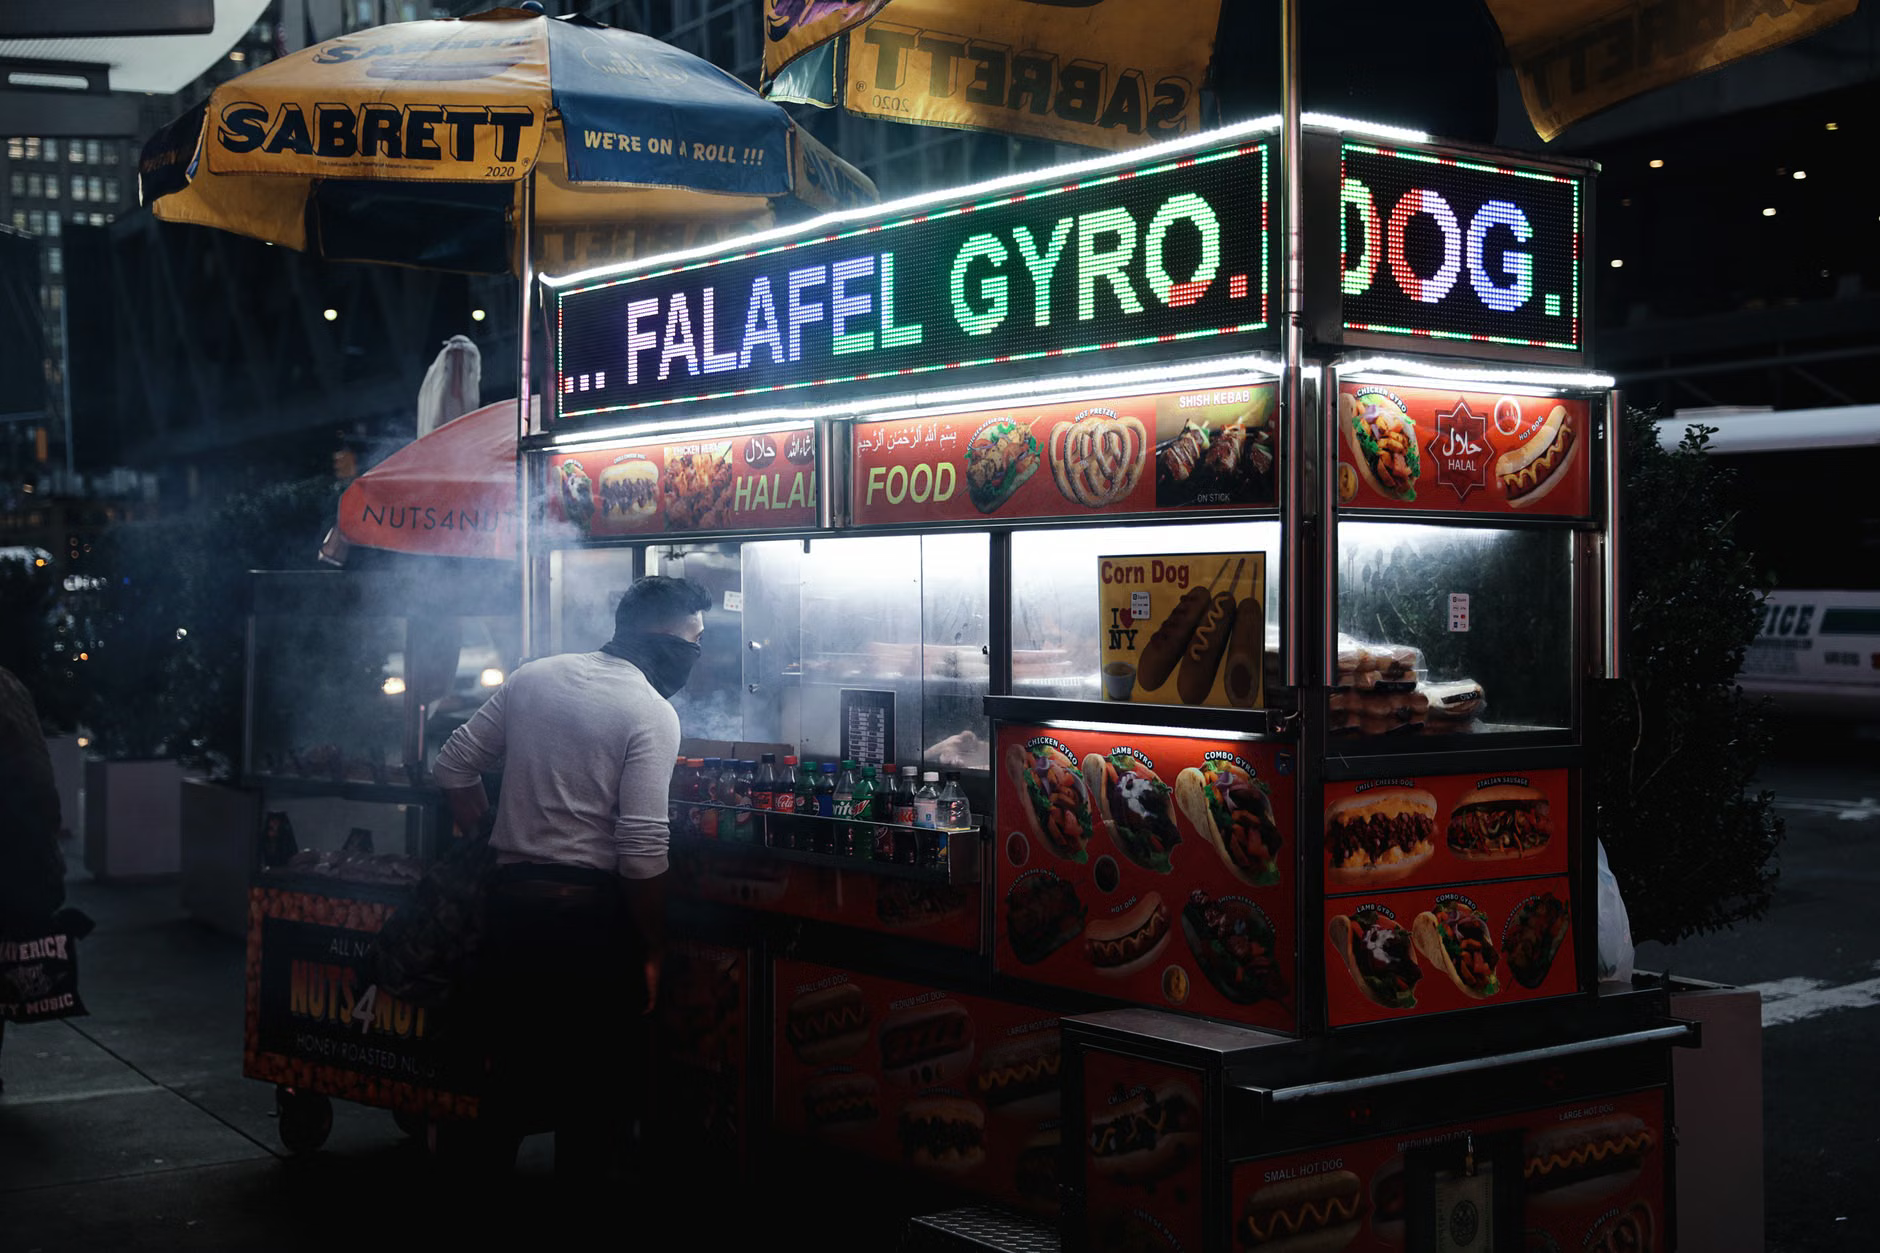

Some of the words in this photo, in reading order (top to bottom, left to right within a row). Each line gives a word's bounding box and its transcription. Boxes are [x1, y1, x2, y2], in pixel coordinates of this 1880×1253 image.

[217, 101, 535, 163] SABRETT
[583, 129, 642, 152] WE'RE
[648, 137, 673, 156] ON
[679, 139, 689, 159] A
[692, 142, 737, 164] ROLL
[742, 147, 765, 167] !!!
[484, 165, 515, 178] 2020
[626, 252, 923, 386] FALAFEL
[950, 192, 1249, 337] GYRO.
[1179, 394, 1211, 408] SHISH
[1213, 390, 1251, 405] KEBAB
[1356, 386, 1389, 398] CHICKEN
[1388, 393, 1408, 414] GYRO
[1075, 409, 1089, 422] HOT
[1089, 407, 1118, 420] PRETZEL
[1518, 430, 1532, 441] HOT
[1530, 415, 1544, 432] DOG
[1442, 427, 1483, 457] حلال
[1448, 459, 1477, 472] HALAL
[866, 462, 956, 505] FOOD
[1209, 493, 1230, 502] STICK
[1101, 560, 1145, 585] Corn
[1151, 559, 1190, 590] Dog
[1108, 629, 1139, 650] NY
[1027, 735, 1059, 750] CHICKEN
[1059, 743, 1079, 767] GYRO
[1110, 746, 1133, 756] LAMB
[1133, 750, 1153, 770] GYRO
[1204, 751, 1234, 762] COMBO
[1234, 755, 1257, 778] GYRO
[1501, 775, 1529, 787] SAUSAGE
[1356, 903, 1377, 914] LAMB
[1376, 904, 1396, 921] GYRO
[1435, 894, 1460, 905] COMBO
[1459, 895, 1478, 911] GYRO
[297, 1033, 337, 1057] HONEY
[340, 1040, 396, 1071] ROASTED
[1559, 1107, 1583, 1121] LARGE
[1583, 1105, 1599, 1116] HOT
[1598, 1103, 1615, 1115] DOG
[1264, 1167, 1297, 1183] SMALL
[1299, 1161, 1321, 1176] HOT
[1321, 1157, 1344, 1171] DOG
